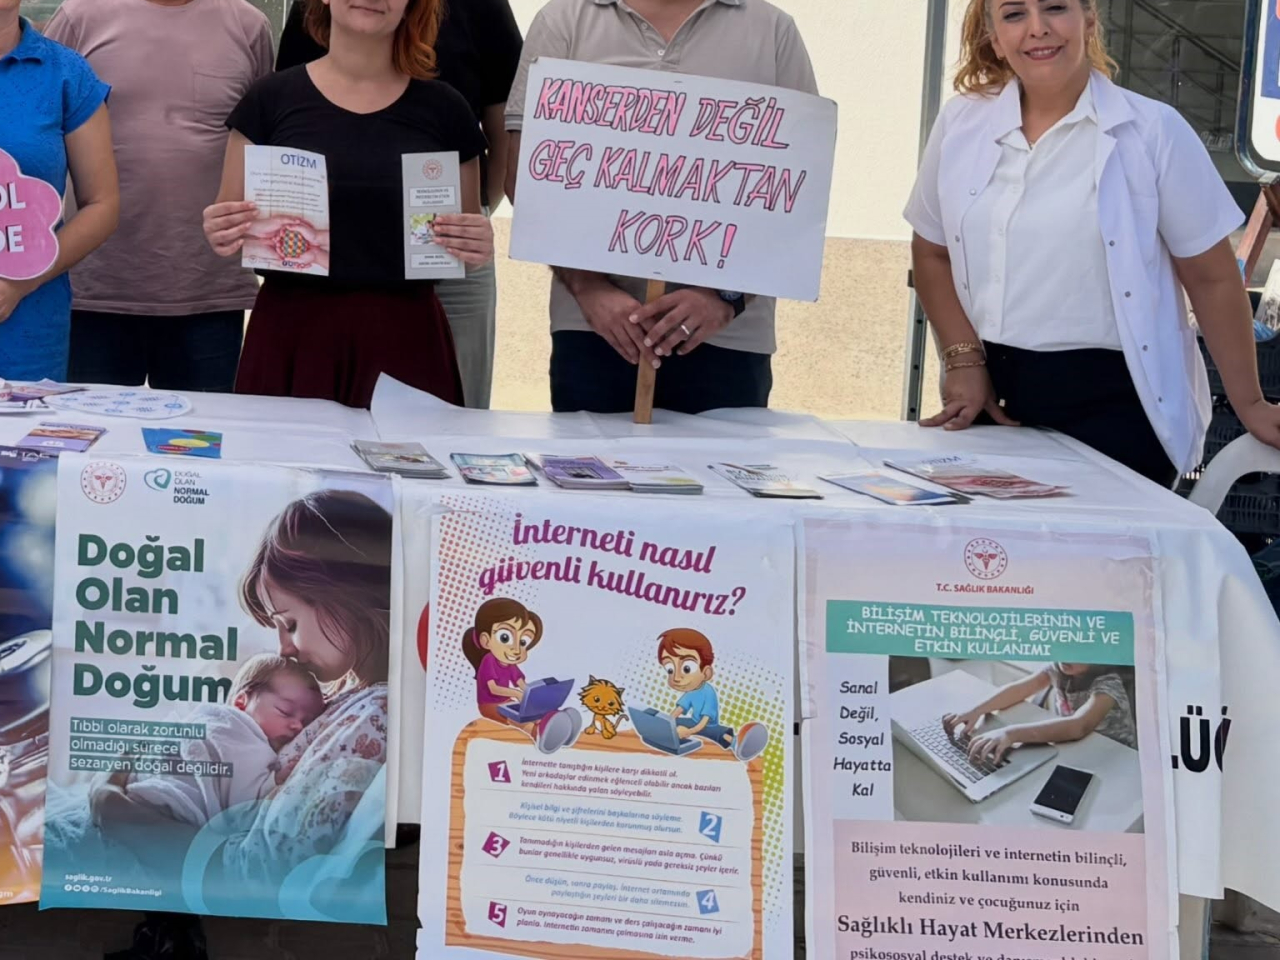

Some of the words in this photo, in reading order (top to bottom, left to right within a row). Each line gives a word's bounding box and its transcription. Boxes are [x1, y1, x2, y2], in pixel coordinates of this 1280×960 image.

[534, 77, 687, 136] KANSERDEN
[689, 97, 789, 149] DEĞİL
[280, 153, 317, 170] OTİZM
[529, 139, 593, 189] GEÇ
[594, 146, 806, 213] KALMAKTAN
[608, 209, 737, 269] KORK!
[173, 495, 205, 505] DOĞUM
[174, 487, 210, 496] NORMAL
[77, 533, 205, 577] Doğal
[639, 541, 717, 574] nasıl
[75, 577, 179, 614] Olan
[478, 556, 583, 596] güvenli
[587, 561, 747, 616] kullanırız?
[936, 583, 952, 592] T.C.
[954, 581, 985, 594] SAĞLIK
[986, 584, 1034, 595] BAKANLIĞI
[862, 606, 925, 622] BİLİŞİM
[931, 609, 1081, 628] TEKNOLOJİLERİNİN
[1087, 616, 1105, 629] VE
[74, 620, 238, 661] Normal
[847, 620, 945, 638] İNTERNETİN
[1030, 628, 1095, 643] GÜVENLİ
[1101, 632, 1120, 644] VE
[914, 639, 961, 653] ETKİN
[967, 642, 1051, 656] KULLANIMI
[72, 664, 232, 708] Doğum
[839, 680, 879, 695] Sanal
[839, 705, 879, 724] Değil,
[71, 719, 105, 735] Tıbbi
[108, 721, 150, 736] olarak
[152, 723, 205, 737] zorunlu
[71, 738, 130, 755] olmadığı
[133, 740, 179, 754] sürece
[838, 731, 885, 750] Sosyal
[71, 757, 131, 773] sezaryen
[134, 757, 172, 775] doğal
[175, 760, 231, 776] değildir.
[494, 763, 506, 781] 1
[833, 757, 892, 776] Hayatta
[852, 782, 874, 797] Kal
[702, 814, 717, 836] 2
[489, 836, 503, 855] 3
[851, 841, 897, 857] Bilişim
[900, 843, 981, 860] teknolojileri
[984, 848, 1001, 859] ve
[1004, 848, 1071, 863] internetin
[1075, 852, 1128, 868] bilinçli,
[869, 866, 921, 882] güvenli,
[924, 868, 959, 881] etkin
[962, 869, 1030, 886] kullanımı
[1033, 873, 1109, 889] konusunda
[701, 891, 715, 910] 4
[898, 891, 955, 906] kendiniz
[959, 895, 975, 906] ve
[978, 895, 1051, 912] çocuğunuz
[1055, 899, 1080, 914] için
[491, 904, 504, 923] 5
[837, 914, 913, 938] Sağlıklı
[919, 917, 978, 942] Hayat
[983, 921, 1144, 946] Merkezlerinden
